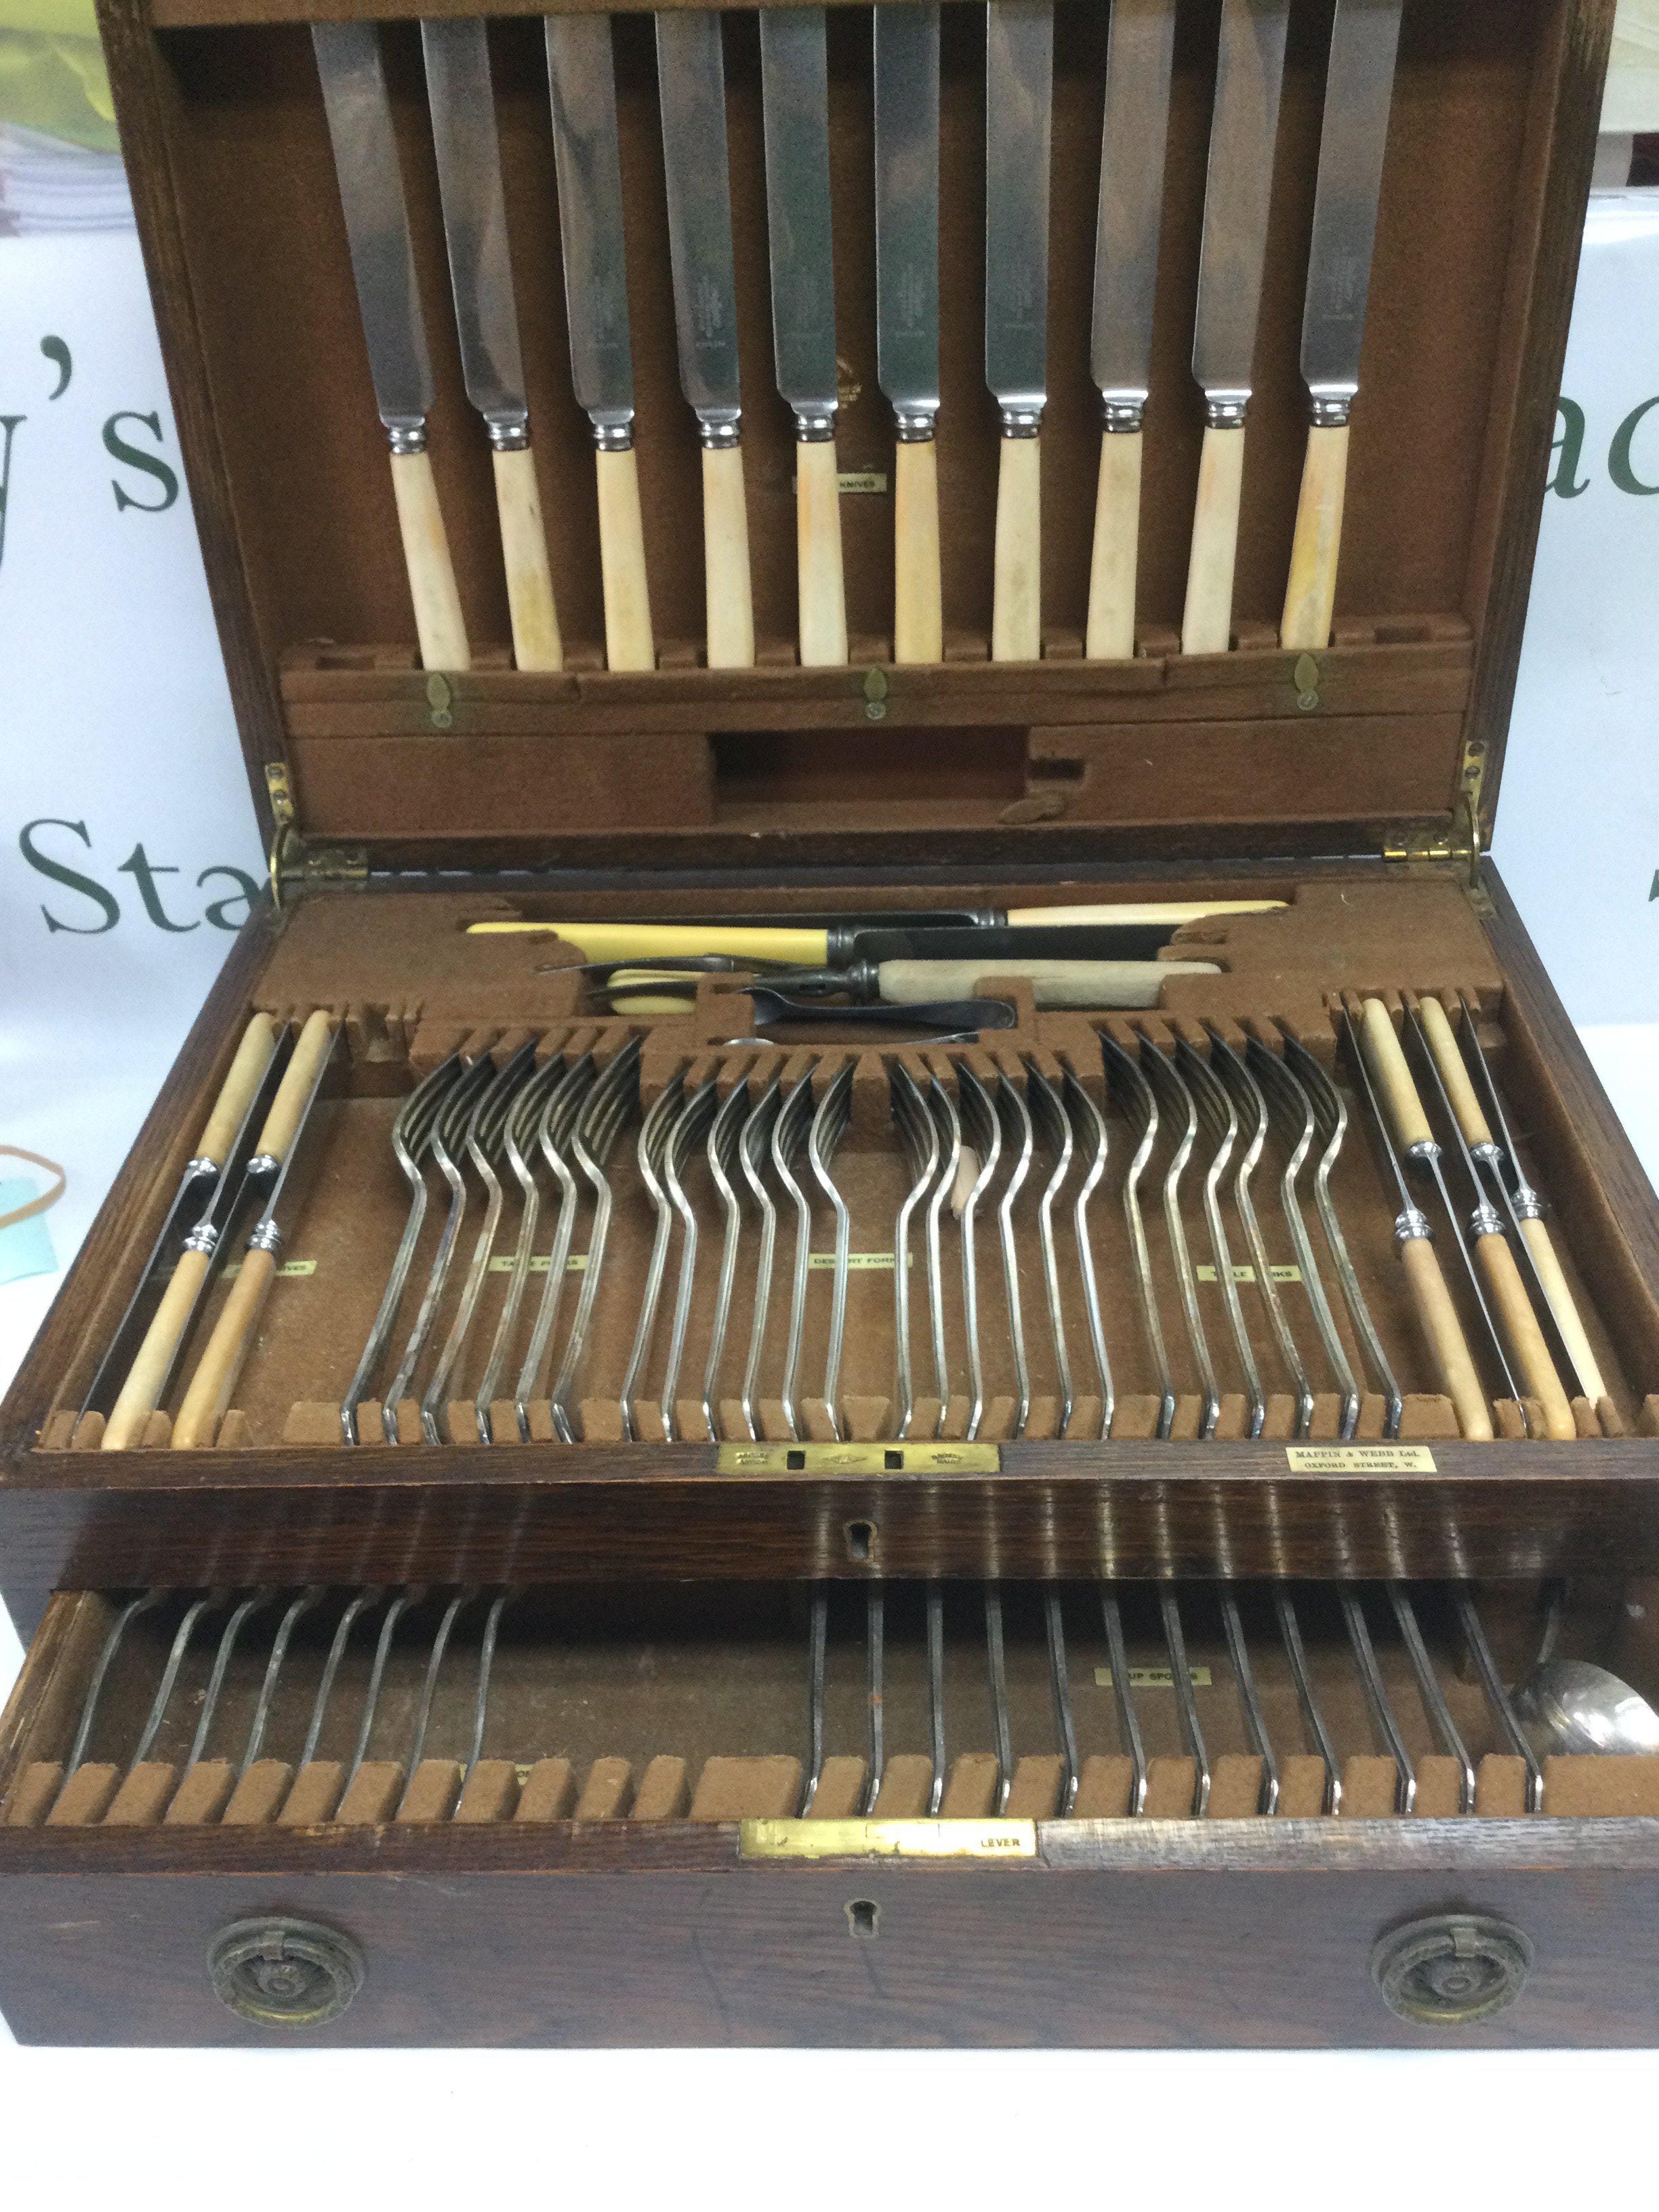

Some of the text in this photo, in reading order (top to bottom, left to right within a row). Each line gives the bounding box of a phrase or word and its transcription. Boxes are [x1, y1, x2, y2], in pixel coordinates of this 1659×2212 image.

[1295, 1450, 1341, 1458] MAPPIN
[1353, 1461, 1398, 1469] STREET,
[981, 1837, 1021, 1847] LEVER
